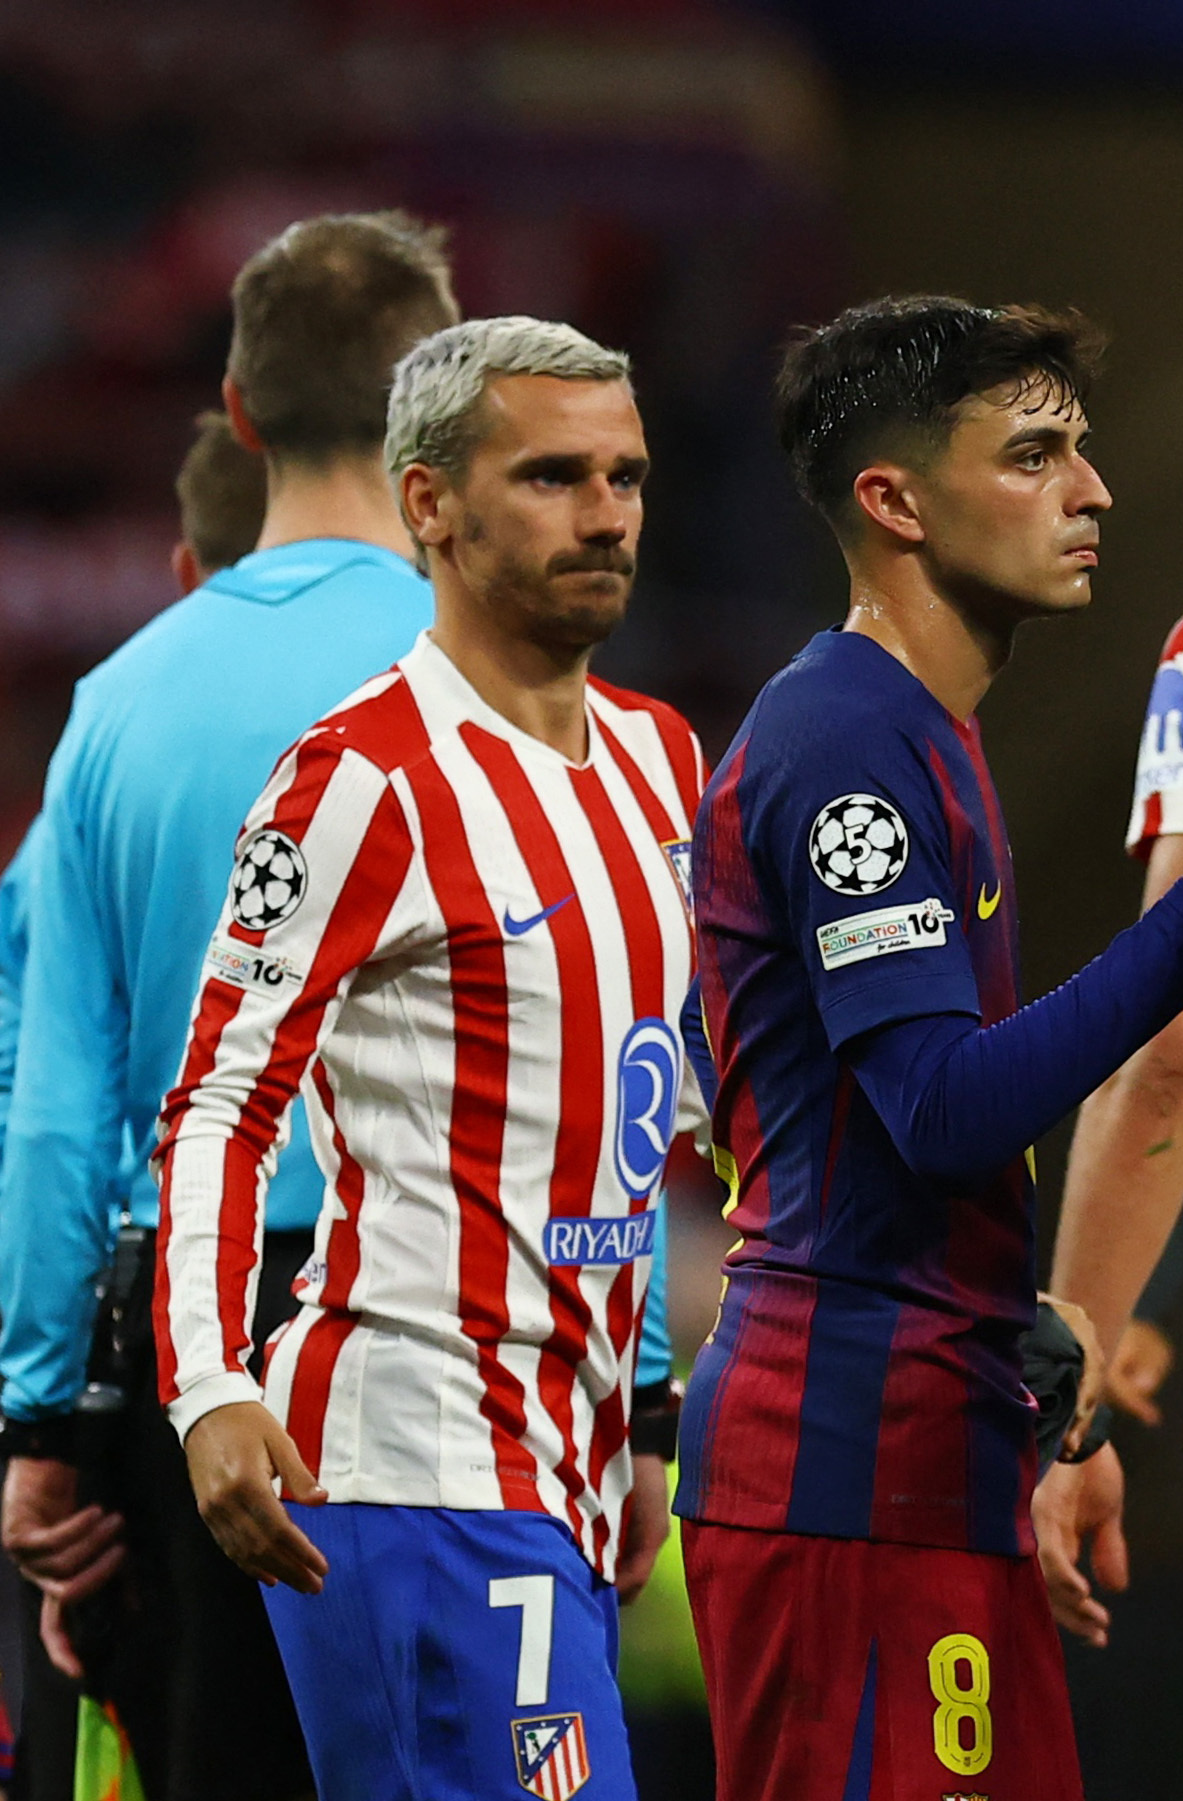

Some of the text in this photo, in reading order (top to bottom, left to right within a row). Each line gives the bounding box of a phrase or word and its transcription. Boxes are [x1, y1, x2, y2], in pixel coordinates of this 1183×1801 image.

[845, 823, 872, 865] 5
[820, 926, 839, 938] UEFA
[822, 923, 908, 954] FOUNDATION
[908, 913, 940, 935] 10
[253, 959, 284, 986] 10
[551, 1217, 649, 1260] RIYADH
[489, 1575, 554, 1706] 7
[928, 1633, 992, 1775] 8
